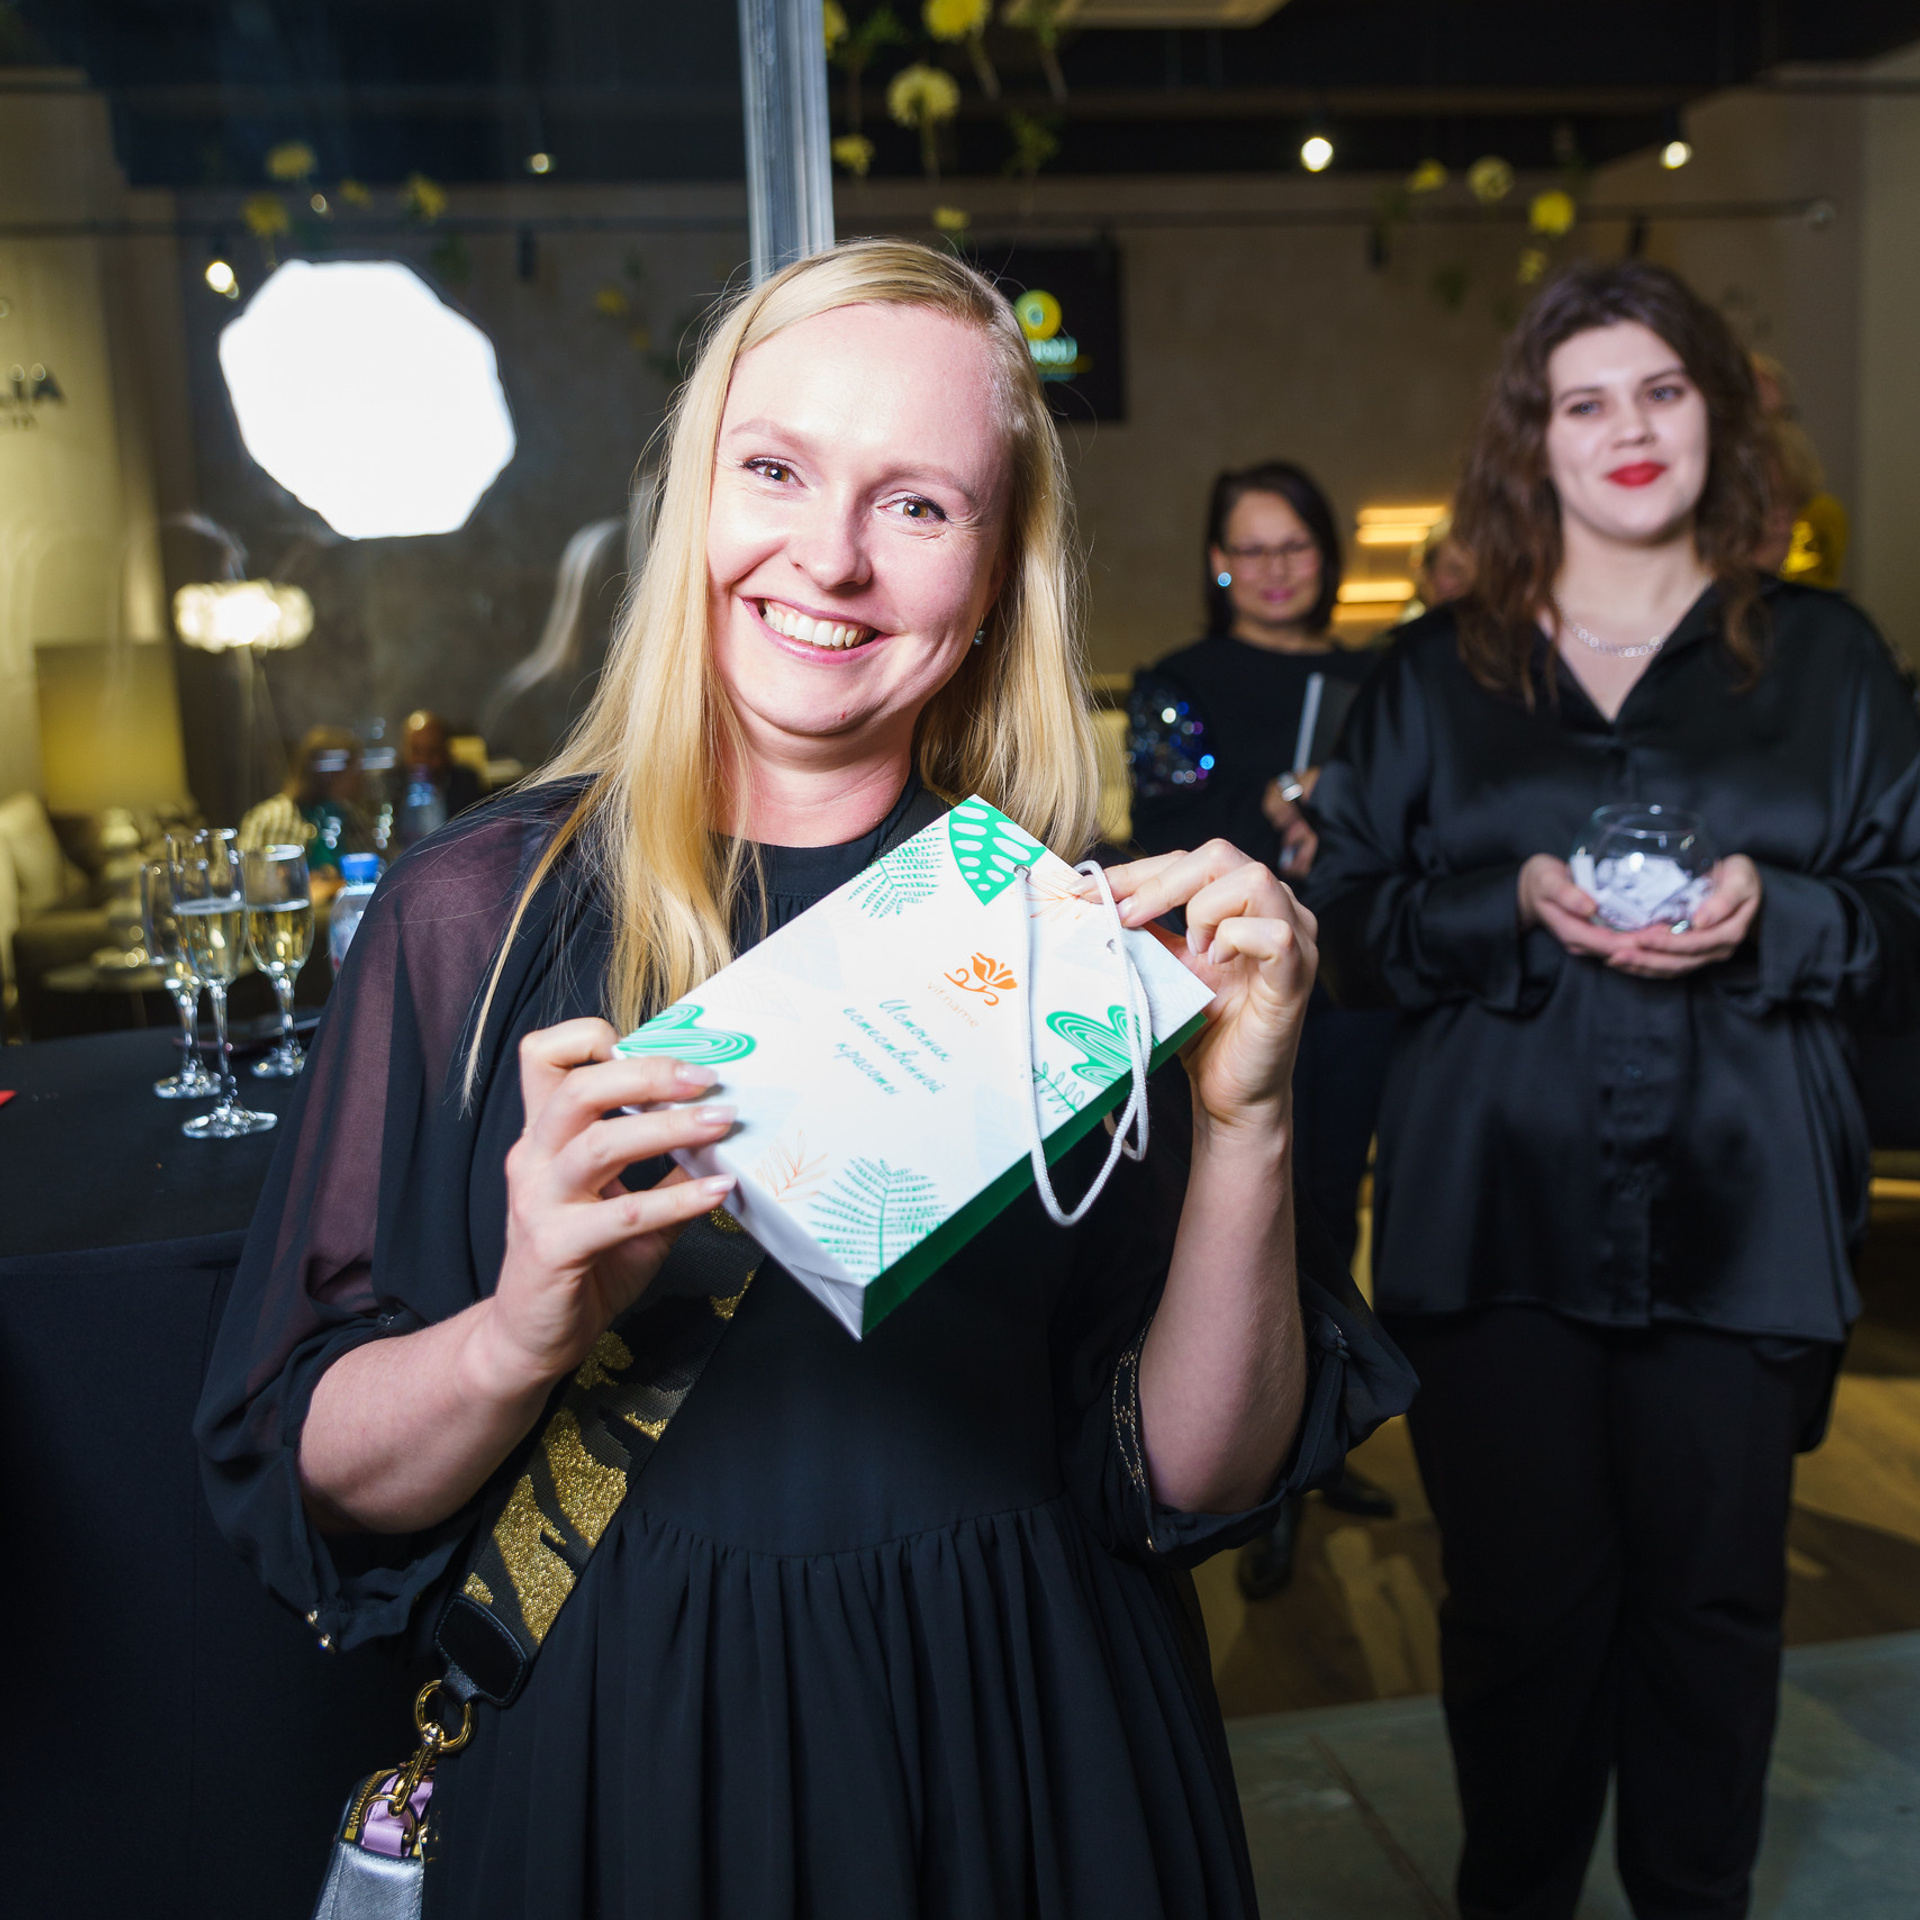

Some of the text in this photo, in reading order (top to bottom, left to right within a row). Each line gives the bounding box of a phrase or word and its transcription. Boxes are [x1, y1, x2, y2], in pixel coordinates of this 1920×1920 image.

[843, 1007, 947, 1094] естественной
[878, 999, 951, 1063] Источник
[833, 1041, 900, 1095] красоты
